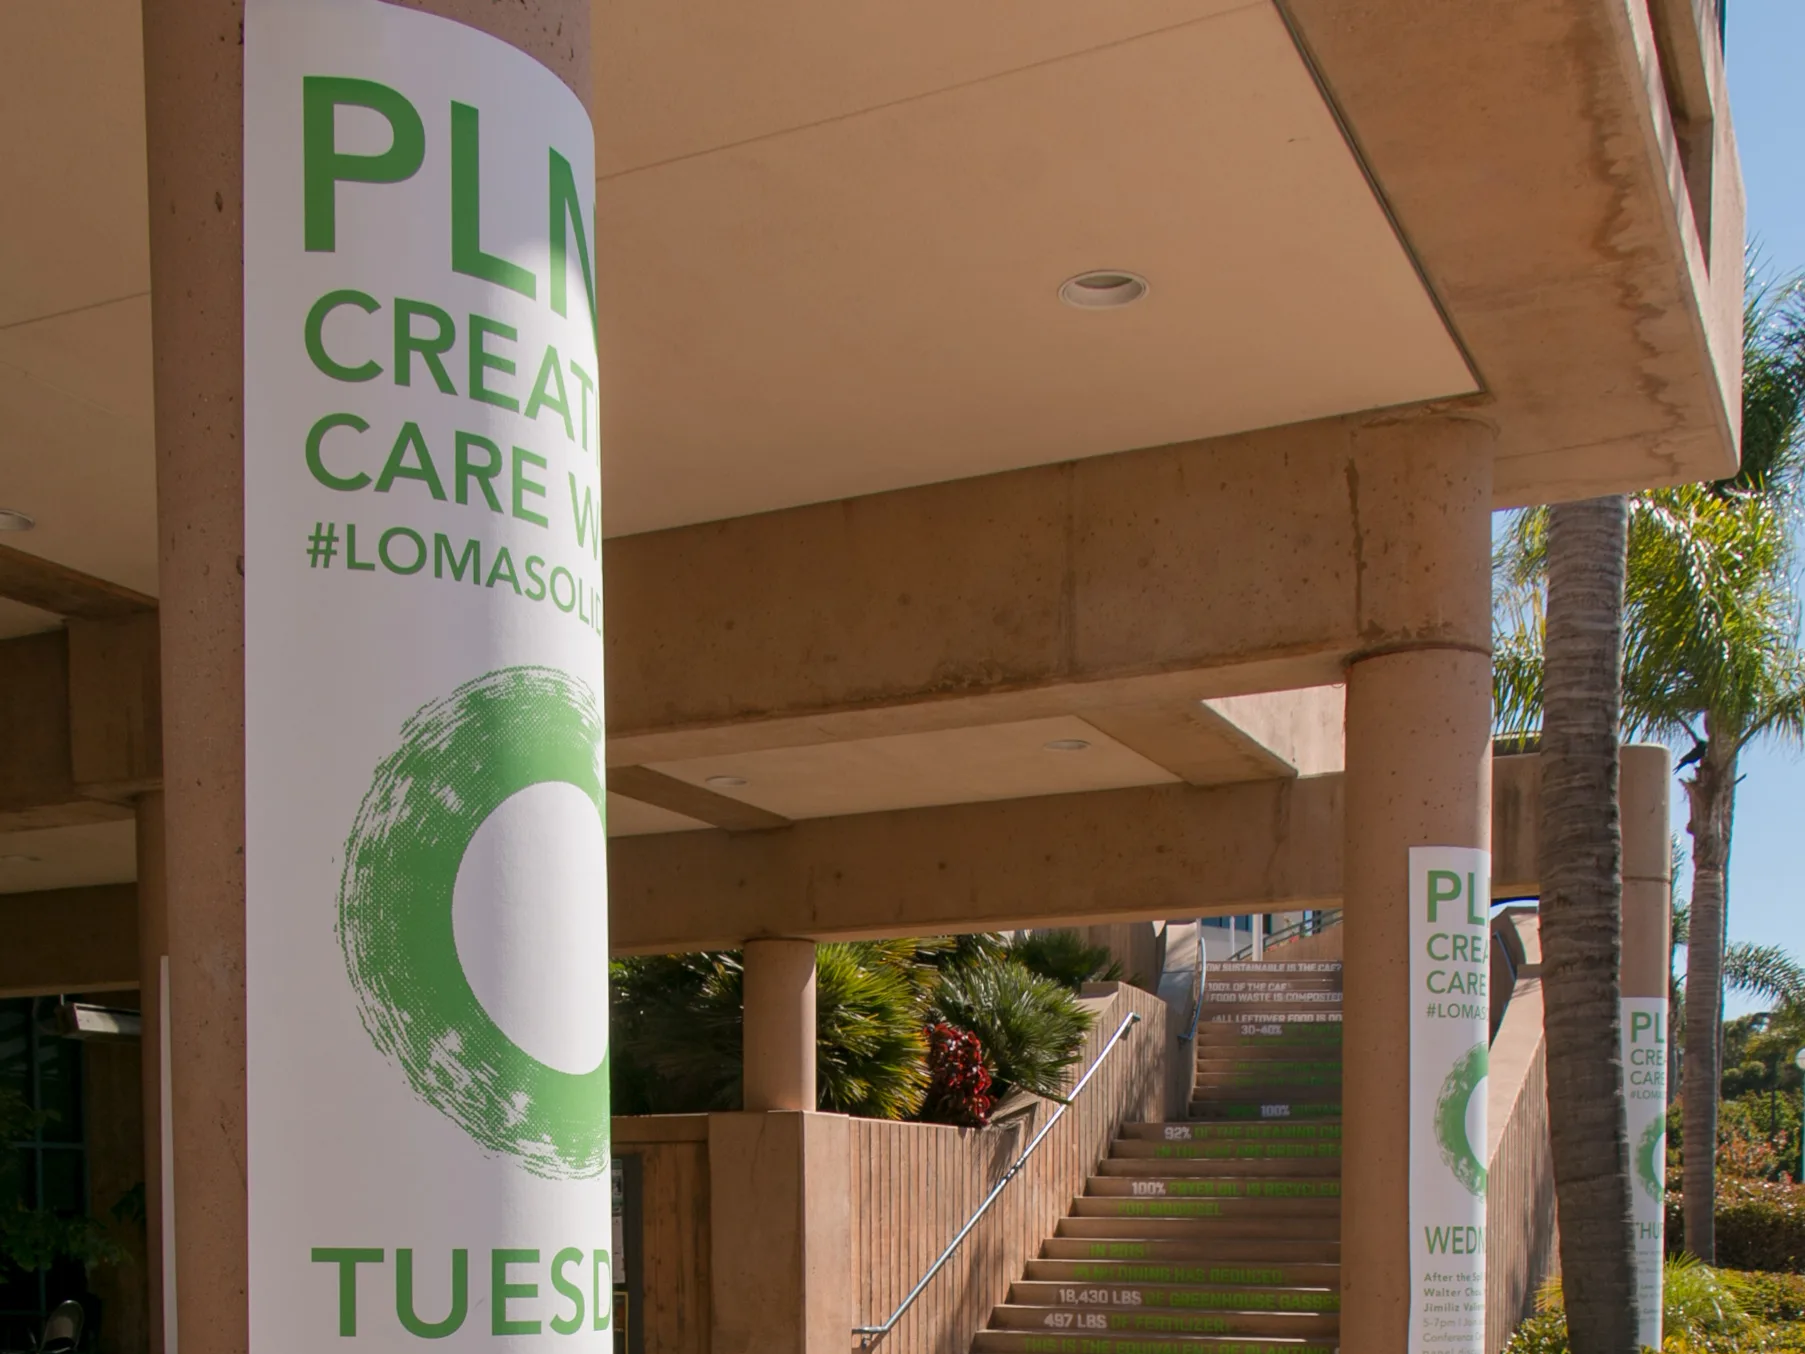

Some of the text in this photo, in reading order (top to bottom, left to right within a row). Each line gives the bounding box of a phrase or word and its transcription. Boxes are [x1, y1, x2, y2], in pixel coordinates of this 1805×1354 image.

[304, 412, 550, 528] CARE
[1426, 869, 1489, 927] PL
[1222, 963, 1285, 972] SUSTAINABLE
[1287, 963, 1297, 972] IS
[1298, 963, 1316, 972] THE
[1232, 982, 1246, 992] OF
[1248, 982, 1267, 992] THE
[1426, 970, 1486, 997] CARE
[1210, 993, 1237, 1002] FOOD
[1238, 992, 1270, 1002] WASTE
[1273, 992, 1284, 1002] IS
[1236, 1014, 1286, 1022] LEFTOVER
[1287, 1014, 1314, 1022] FOOD
[1260, 1105, 1290, 1117] 100%
[1164, 1126, 1191, 1140] 92%
[1216, 1126, 1241, 1139] THE
[1131, 1181, 1165, 1196] 100%
[1264, 1181, 1341, 1198] RECYCLED
[311, 1246, 611, 1340] TUESD
[1059, 1289, 1109, 1304] 18,430
[1112, 1290, 1143, 1305] LBS
[1169, 1292, 1276, 1308] GREENHOUSE
[1423, 1287, 1461, 1297] Walter
[1044, 1313, 1074, 1328] 497
[1078, 1314, 1107, 1329] LBS
[1024, 1337, 1058, 1353] THIS
[1061, 1338, 1076, 1353] IS
[1080, 1338, 1109, 1354] THE
